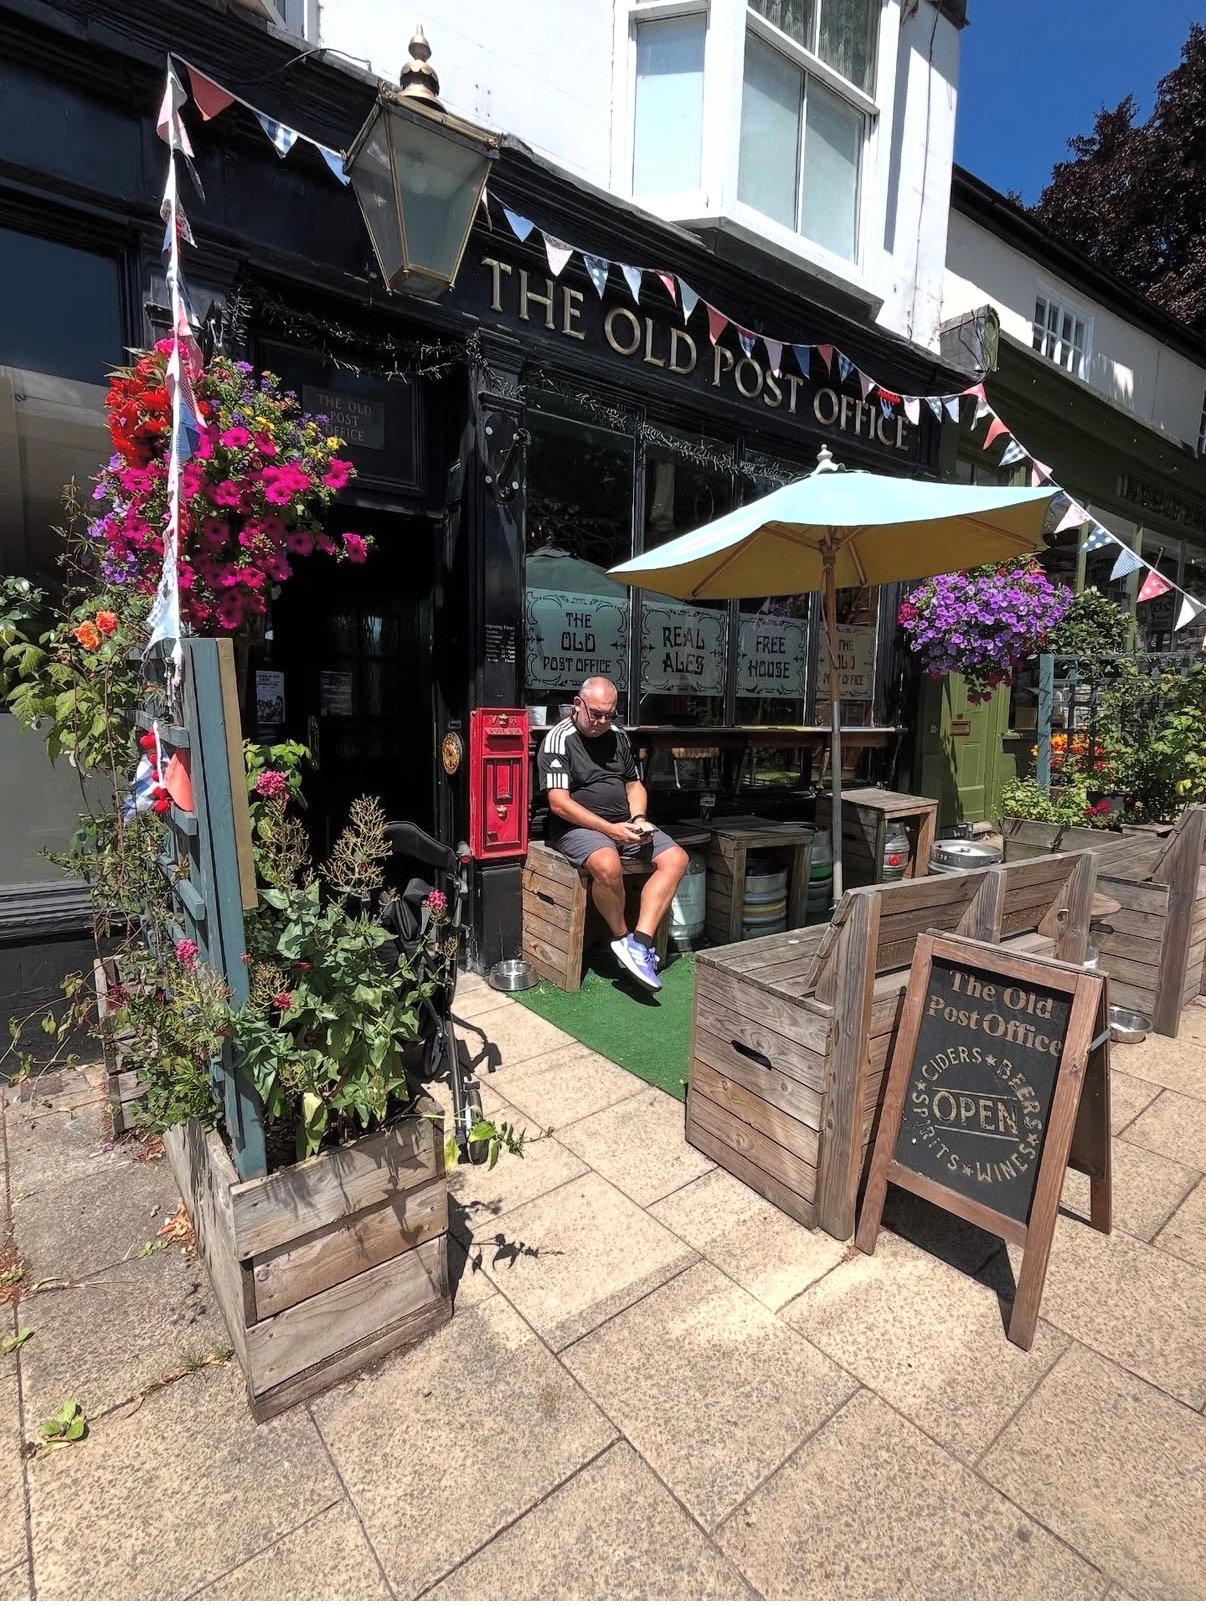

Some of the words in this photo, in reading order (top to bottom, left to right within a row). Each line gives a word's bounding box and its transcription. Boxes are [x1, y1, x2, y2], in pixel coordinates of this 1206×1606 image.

[481, 257, 586, 341] THE
[604, 307, 698, 374] OLD
[711, 344, 804, 414] POST
[813, 386, 910, 451] OFFICE
[318, 394, 341, 410] THE
[348, 401, 372, 416] OLD
[331, 411, 360, 427] POST
[325, 424, 365, 442] OFFICE
[566, 612, 592, 629] THE
[561, 631, 596, 652] OLD
[662, 626, 704, 650] REAL
[756, 635, 786, 654] FREE
[838, 639, 854, 651] THE
[543, 656, 574, 672] POST
[575, 658, 611, 673] OFFICE
[663, 652, 704, 675] ALES
[748, 660, 791, 679] HOUSE
[950, 970, 996, 1002] The
[1003, 986, 1054, 1020] Old
[927, 994, 980, 1031] Post
[982, 1012, 1064, 1058] Office
[921, 1045, 983, 1083] CIDERS
[996, 1058, 1044, 1132] BEERS
[932, 1090, 1020, 1136] OPEN
[975, 1142, 1038, 1184] WINES
